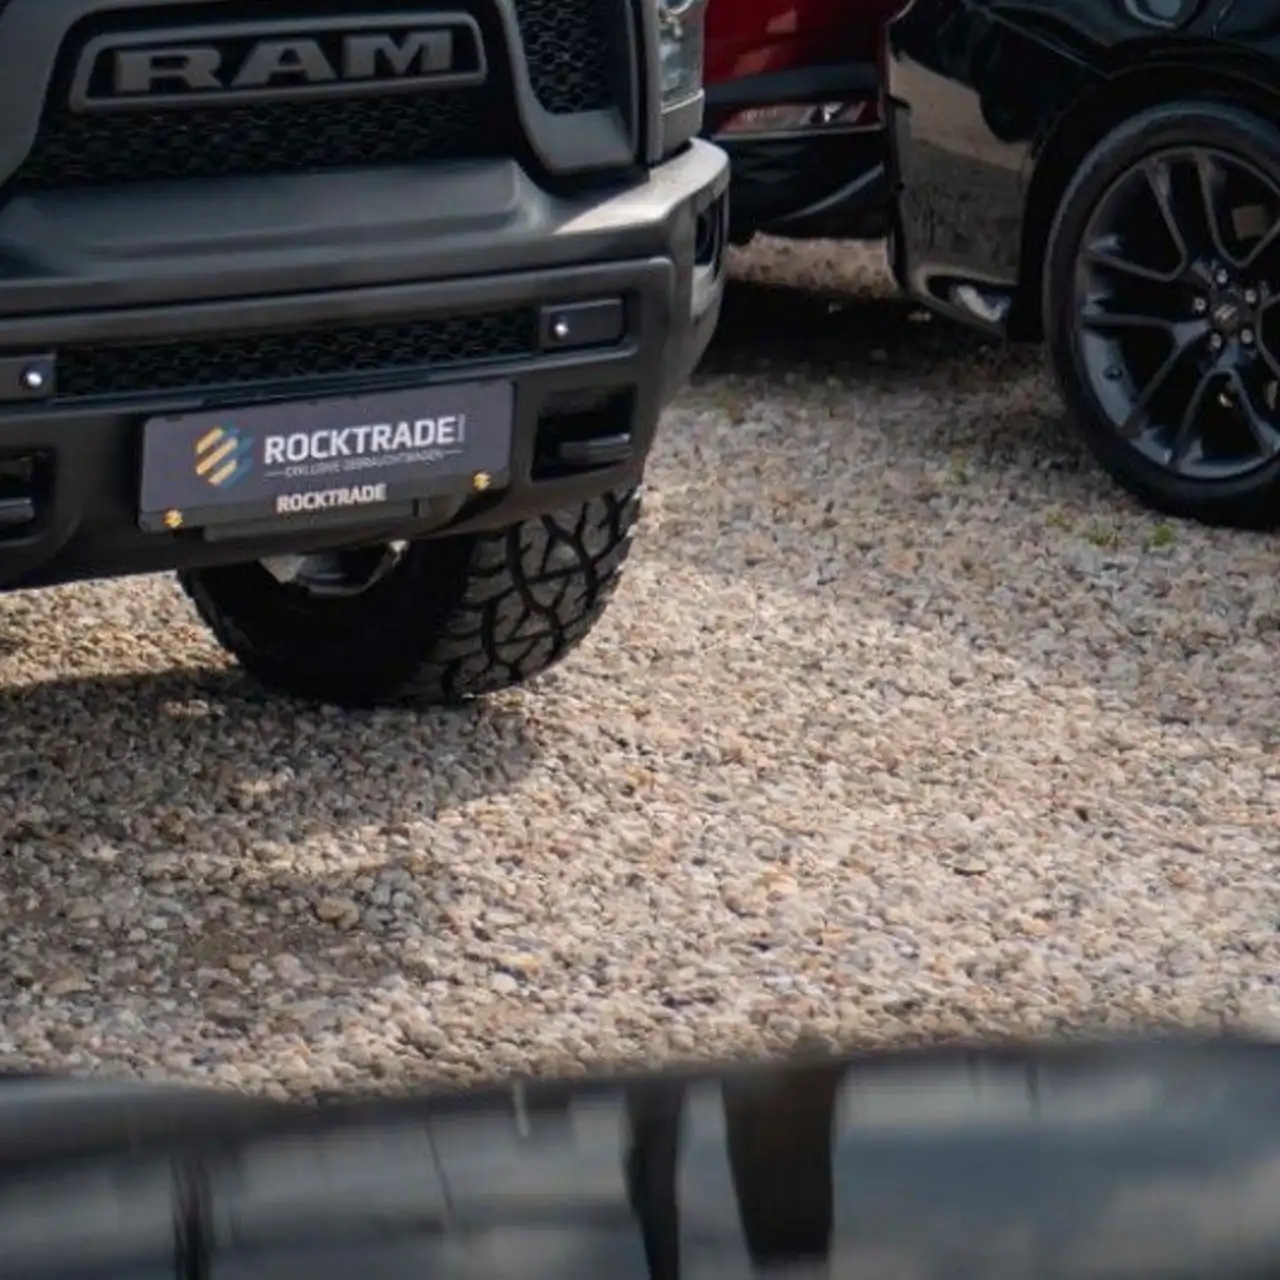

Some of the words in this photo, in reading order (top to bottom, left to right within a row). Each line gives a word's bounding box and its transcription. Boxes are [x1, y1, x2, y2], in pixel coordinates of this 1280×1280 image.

[114, 29, 454, 93] RAM
[264, 416, 456, 464] ROCKTRADE
[275, 483, 387, 513] ROCKTRADE
